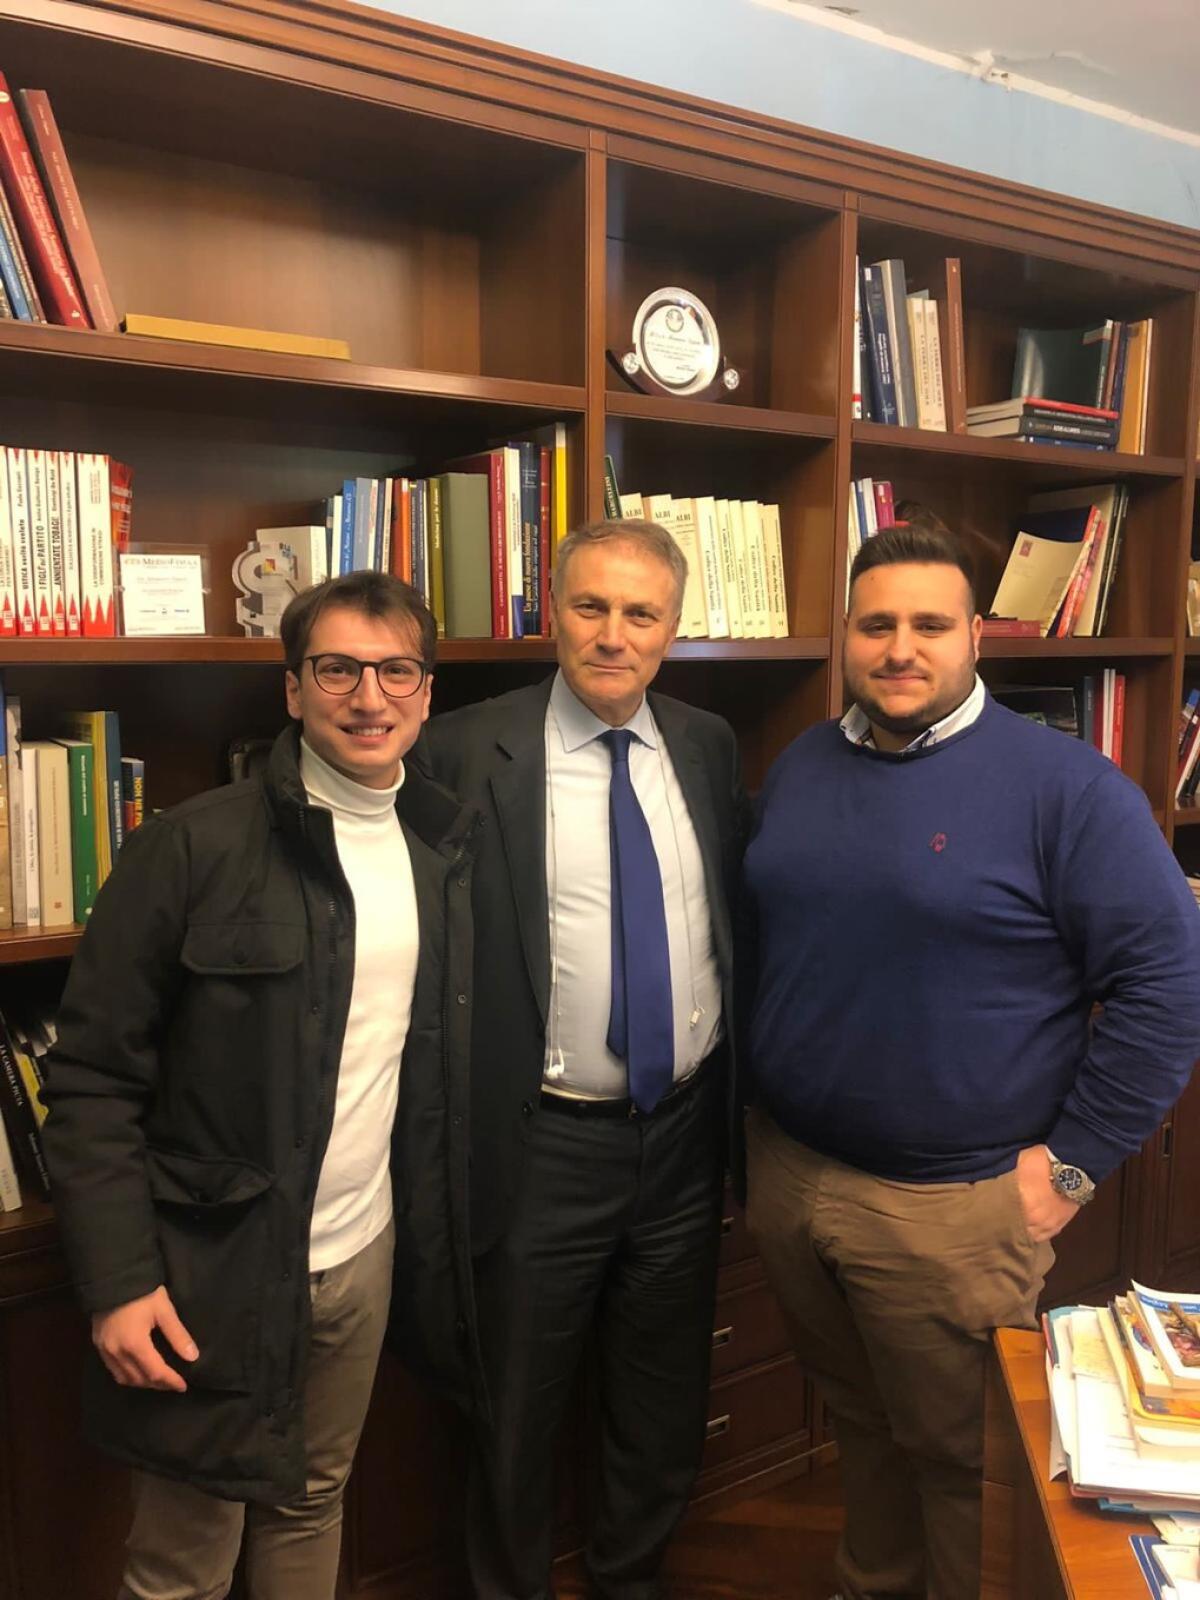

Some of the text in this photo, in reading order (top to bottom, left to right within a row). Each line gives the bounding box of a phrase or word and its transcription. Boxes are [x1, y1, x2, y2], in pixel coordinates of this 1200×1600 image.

[36, 525, 45, 557] PARTITO
[53, 545, 61, 586] ANNIENTATE
[134, 776, 143, 796] NON
